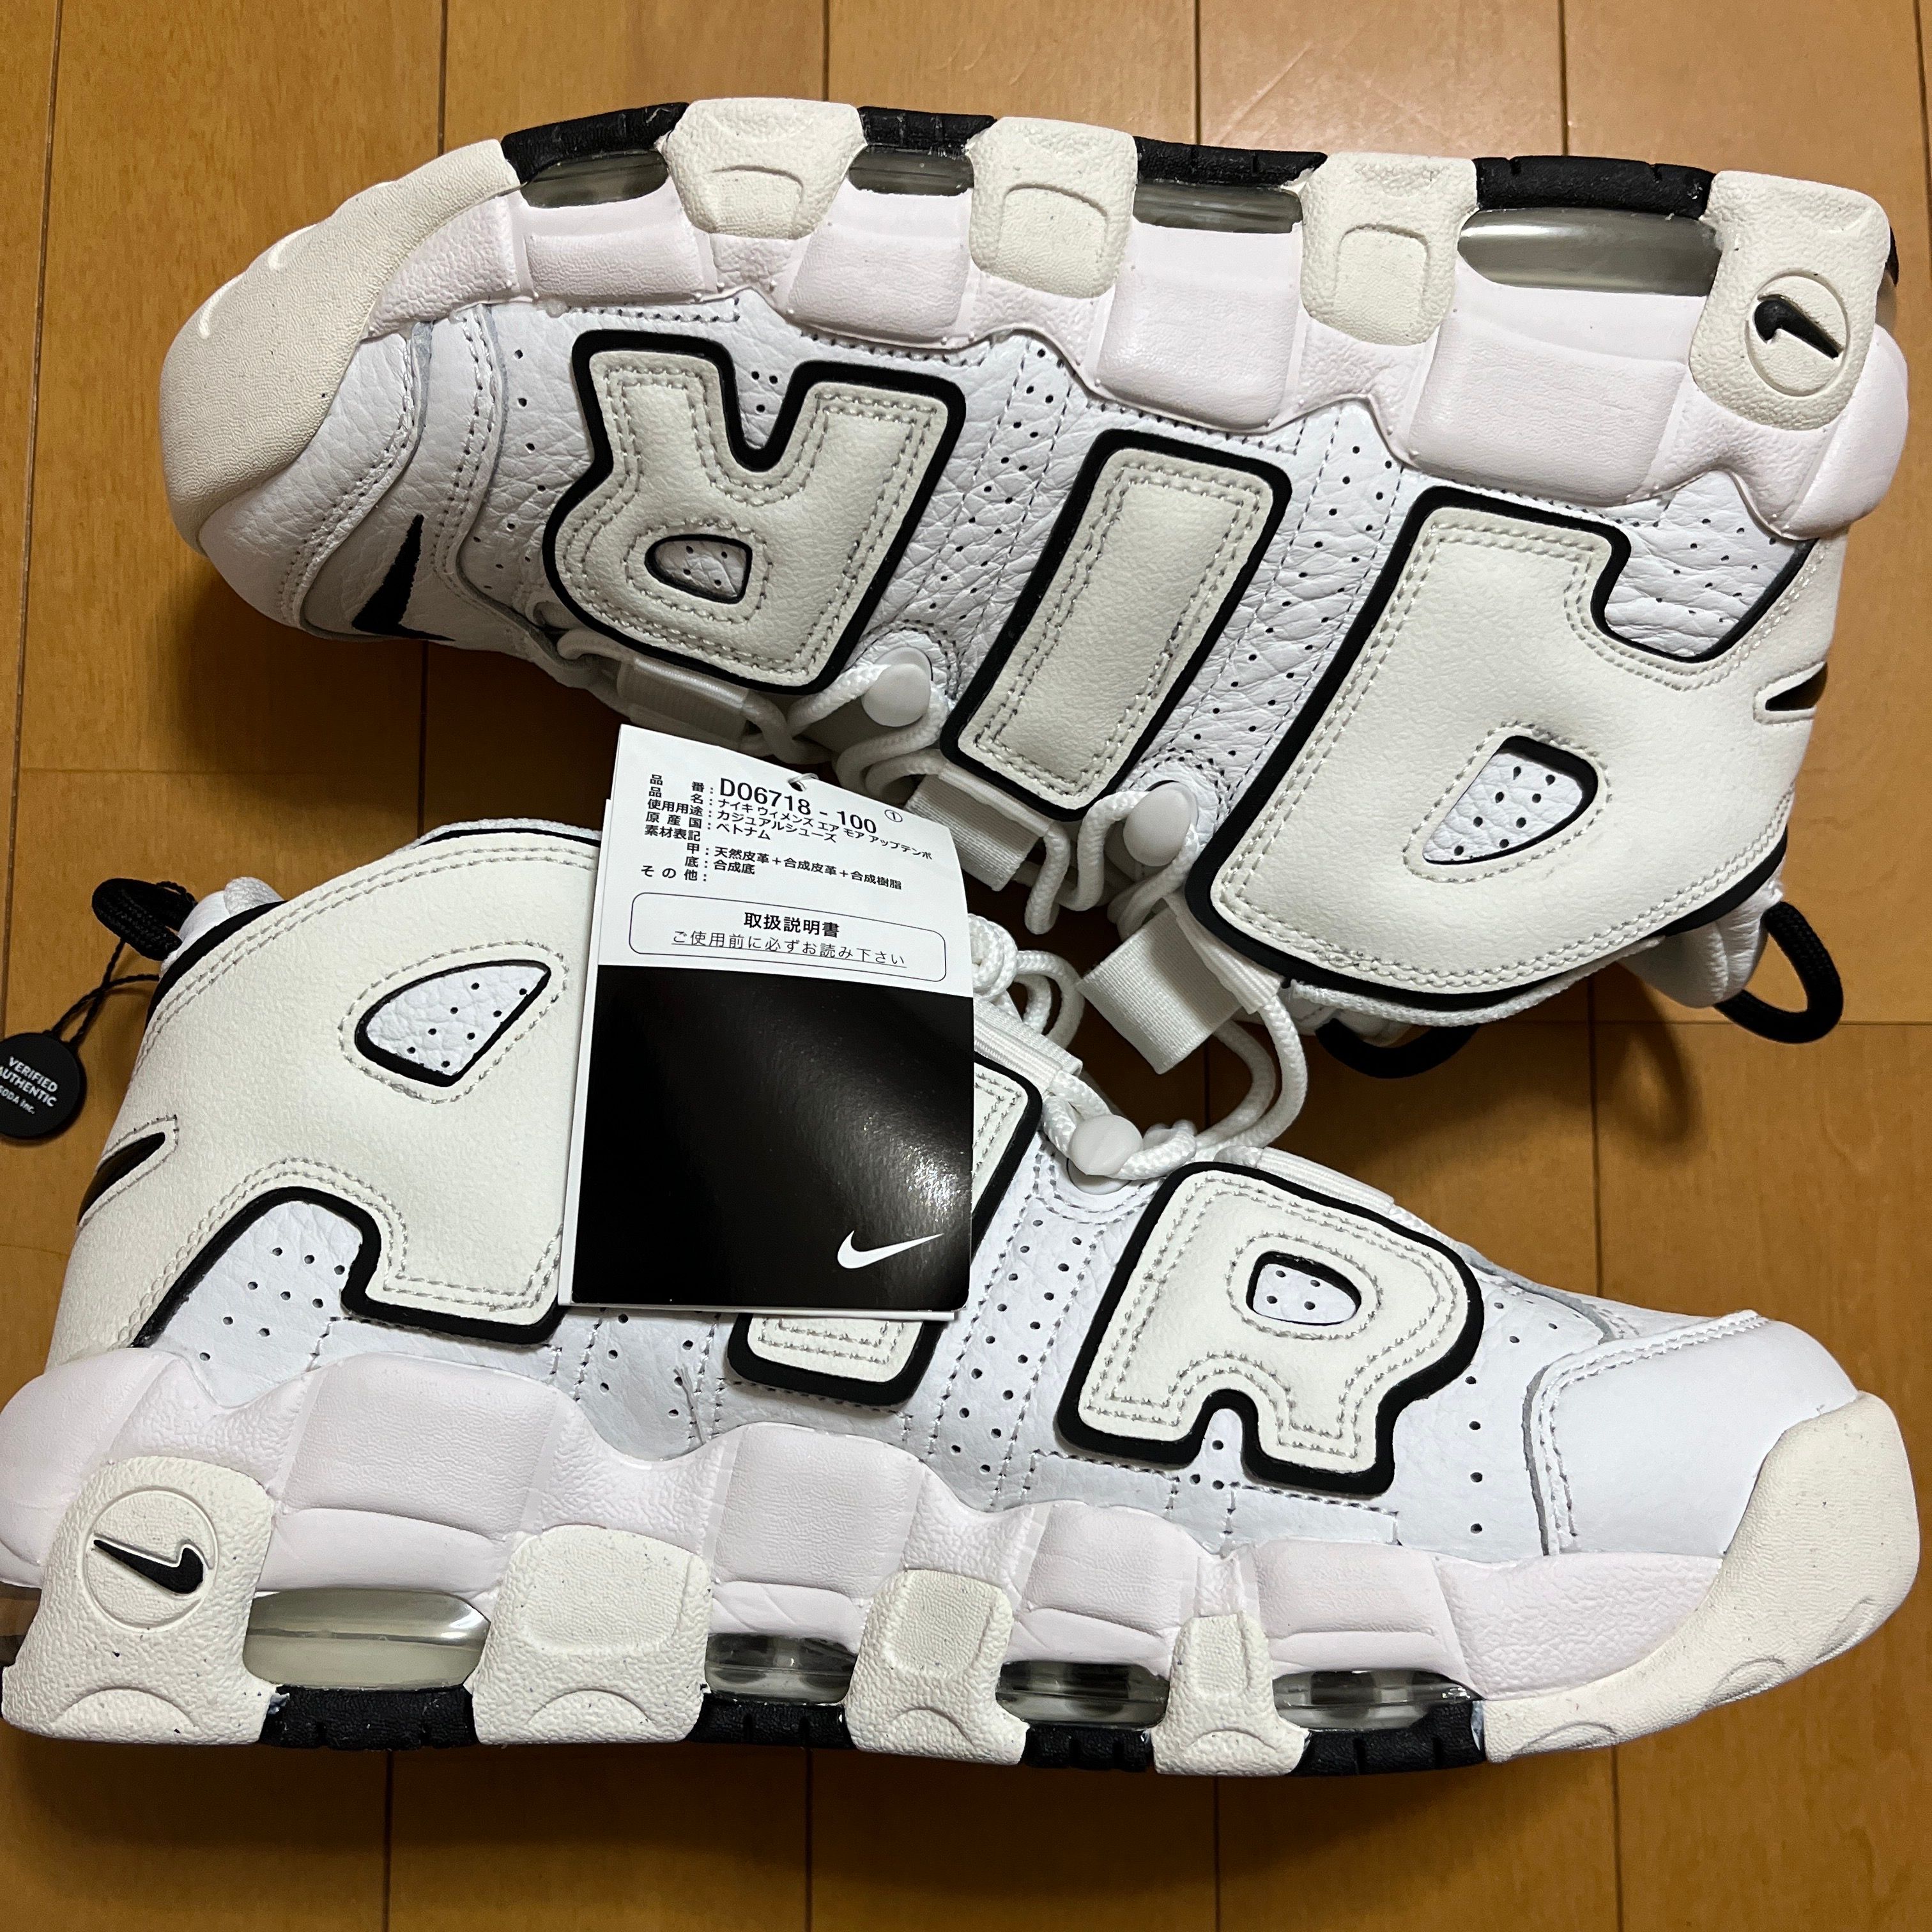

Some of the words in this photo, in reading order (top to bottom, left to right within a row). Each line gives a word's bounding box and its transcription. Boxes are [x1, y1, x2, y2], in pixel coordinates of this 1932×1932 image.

[644, 824, 701, 842] 素材表記
[716, 823, 771, 841] ベトナム
[836, 811, 877, 834] 100
[713, 859, 755, 875] 合成底
[744, 912, 840, 939] 取扱説明書
[673, 930, 905, 965] ご使用前に必ずお読み下さい
[9, 1055, 58, 1092] VERIFIED
